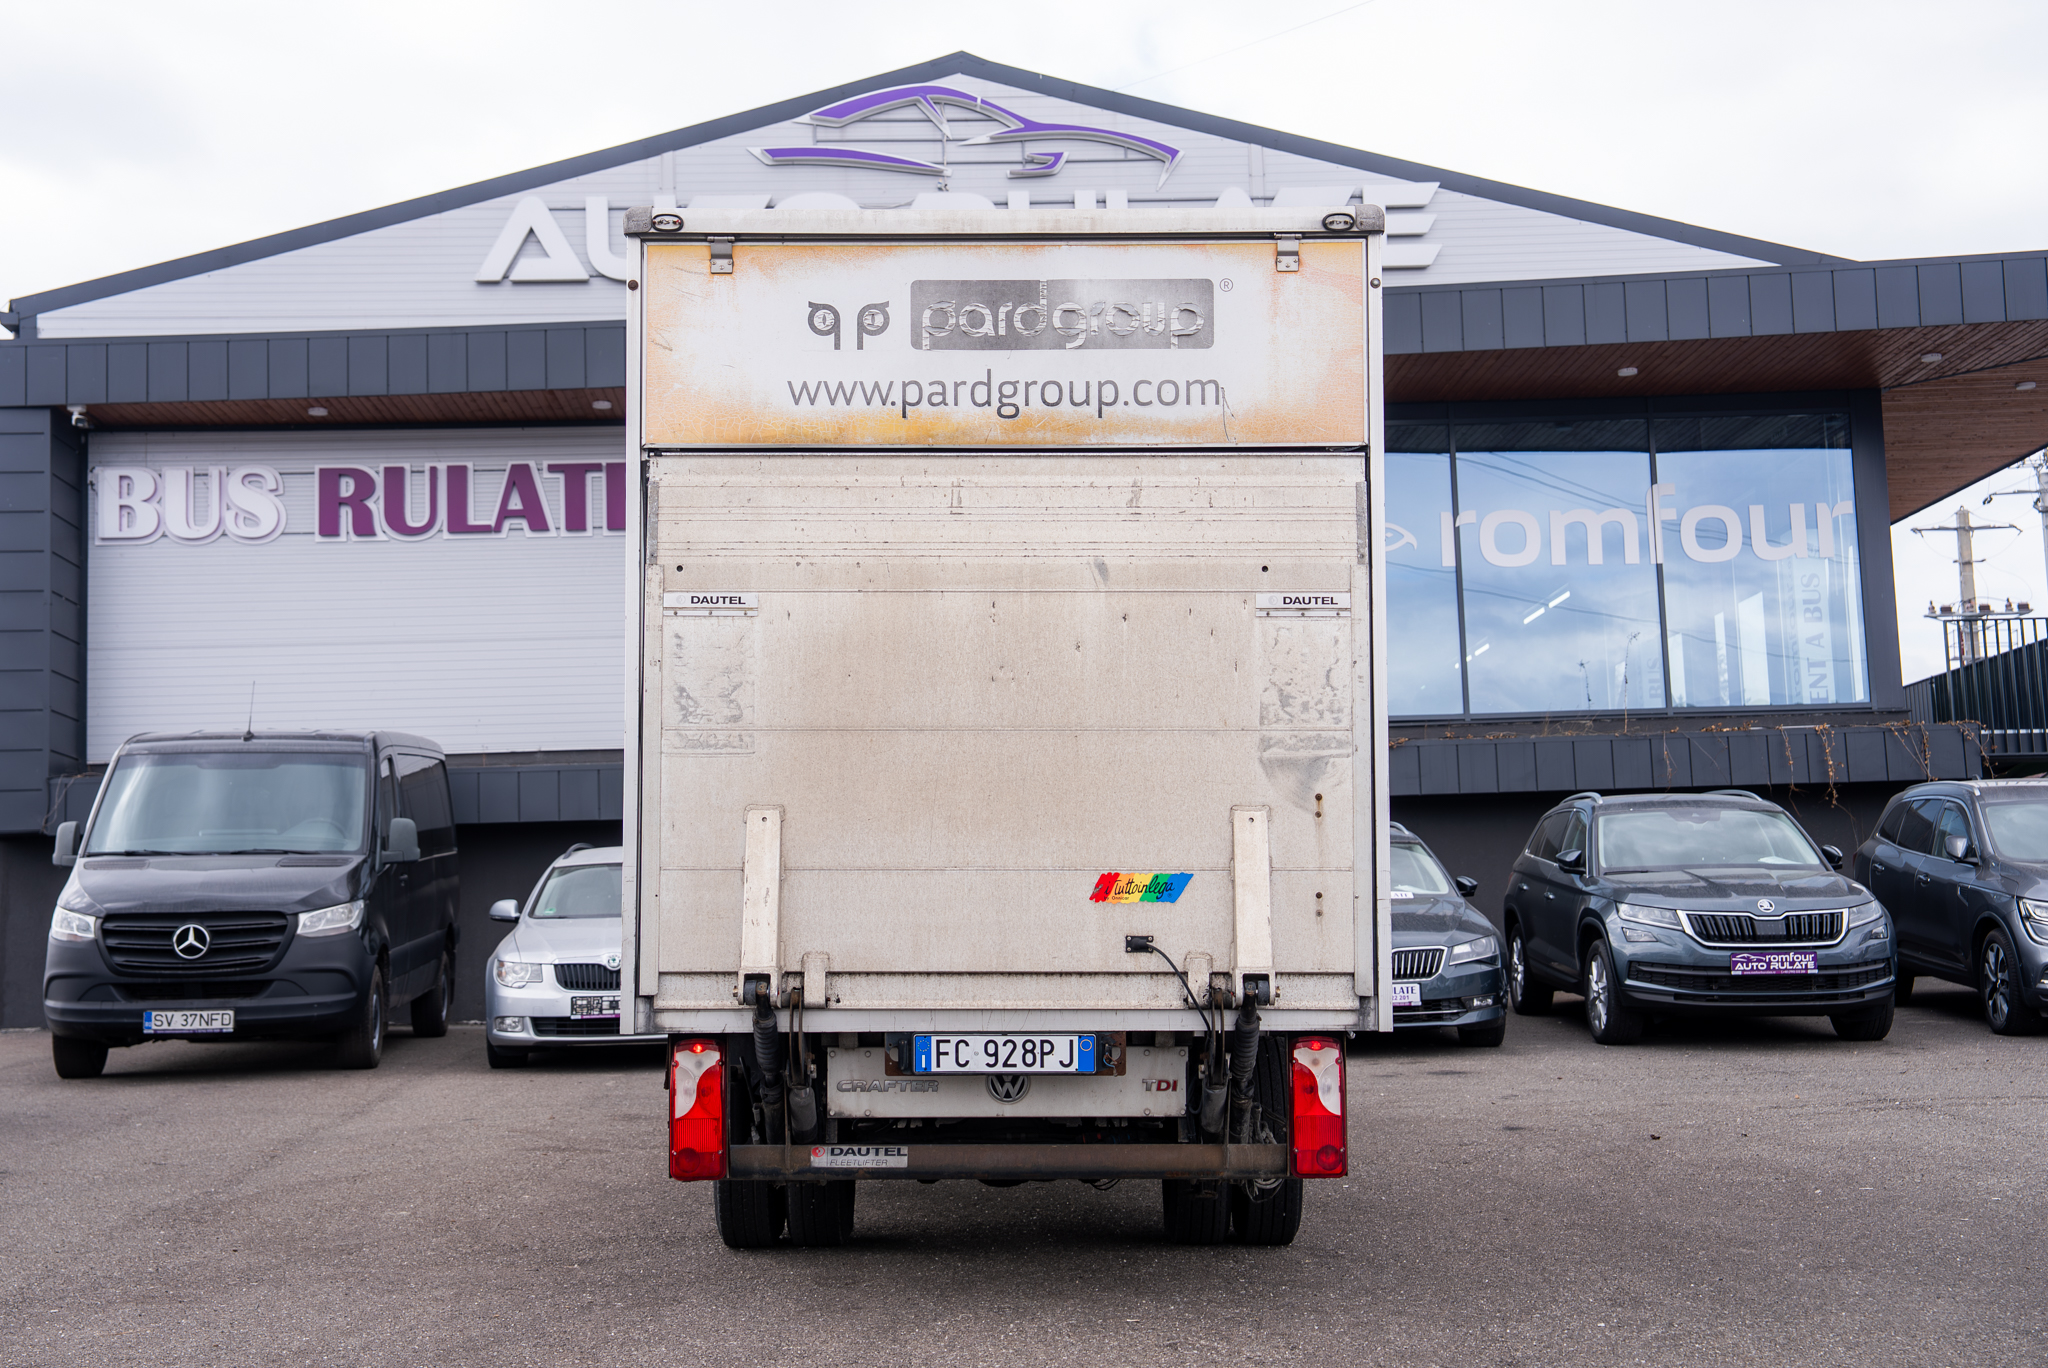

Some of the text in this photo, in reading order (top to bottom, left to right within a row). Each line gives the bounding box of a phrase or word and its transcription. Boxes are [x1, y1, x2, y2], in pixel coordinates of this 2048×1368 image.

[922, 279, 1206, 350] pardgroup
[787, 368, 1220, 419] www.pardgroup.com
[95, 465, 285, 543] BUS
[1440, 483, 1854, 567] romfour
[690, 595, 746, 605] DAUTEL
[1282, 596, 1338, 605] DAUTEL
[1765, 952, 1815, 962] romfour
[1735, 961, 1815, 971] AUTO RULATE
[153, 1013, 174, 1027] SV
[181, 1012, 232, 1027] 37NFD
[935, 1038, 1075, 1068] FC 928PJ
[836, 1079, 940, 1093] CRAFTER
[1142, 1078, 1178, 1092] TDI
[830, 1147, 908, 1157] DAUTEL
[829, 1158, 888, 1167] FLEETLIFTER
